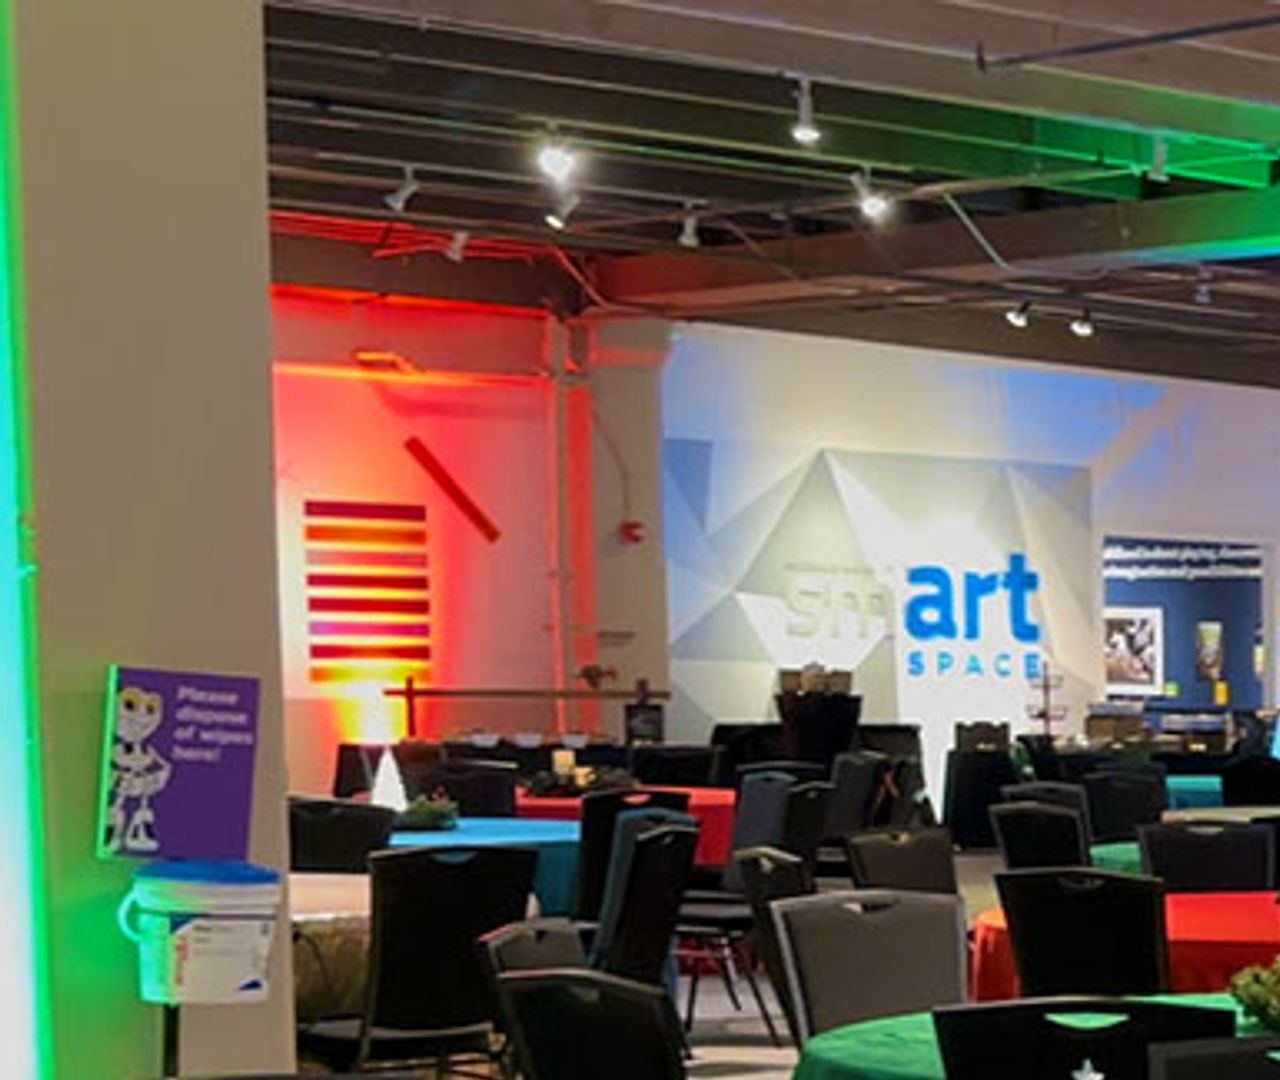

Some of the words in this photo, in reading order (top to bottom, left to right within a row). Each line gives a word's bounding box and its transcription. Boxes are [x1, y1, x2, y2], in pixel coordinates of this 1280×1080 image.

[906, 650, 1041, 681] SPACE
[178, 685, 239, 706] Please
[176, 705, 248, 725] dispose
[174, 725, 196, 740] of
[200, 730, 253, 746] wipes
